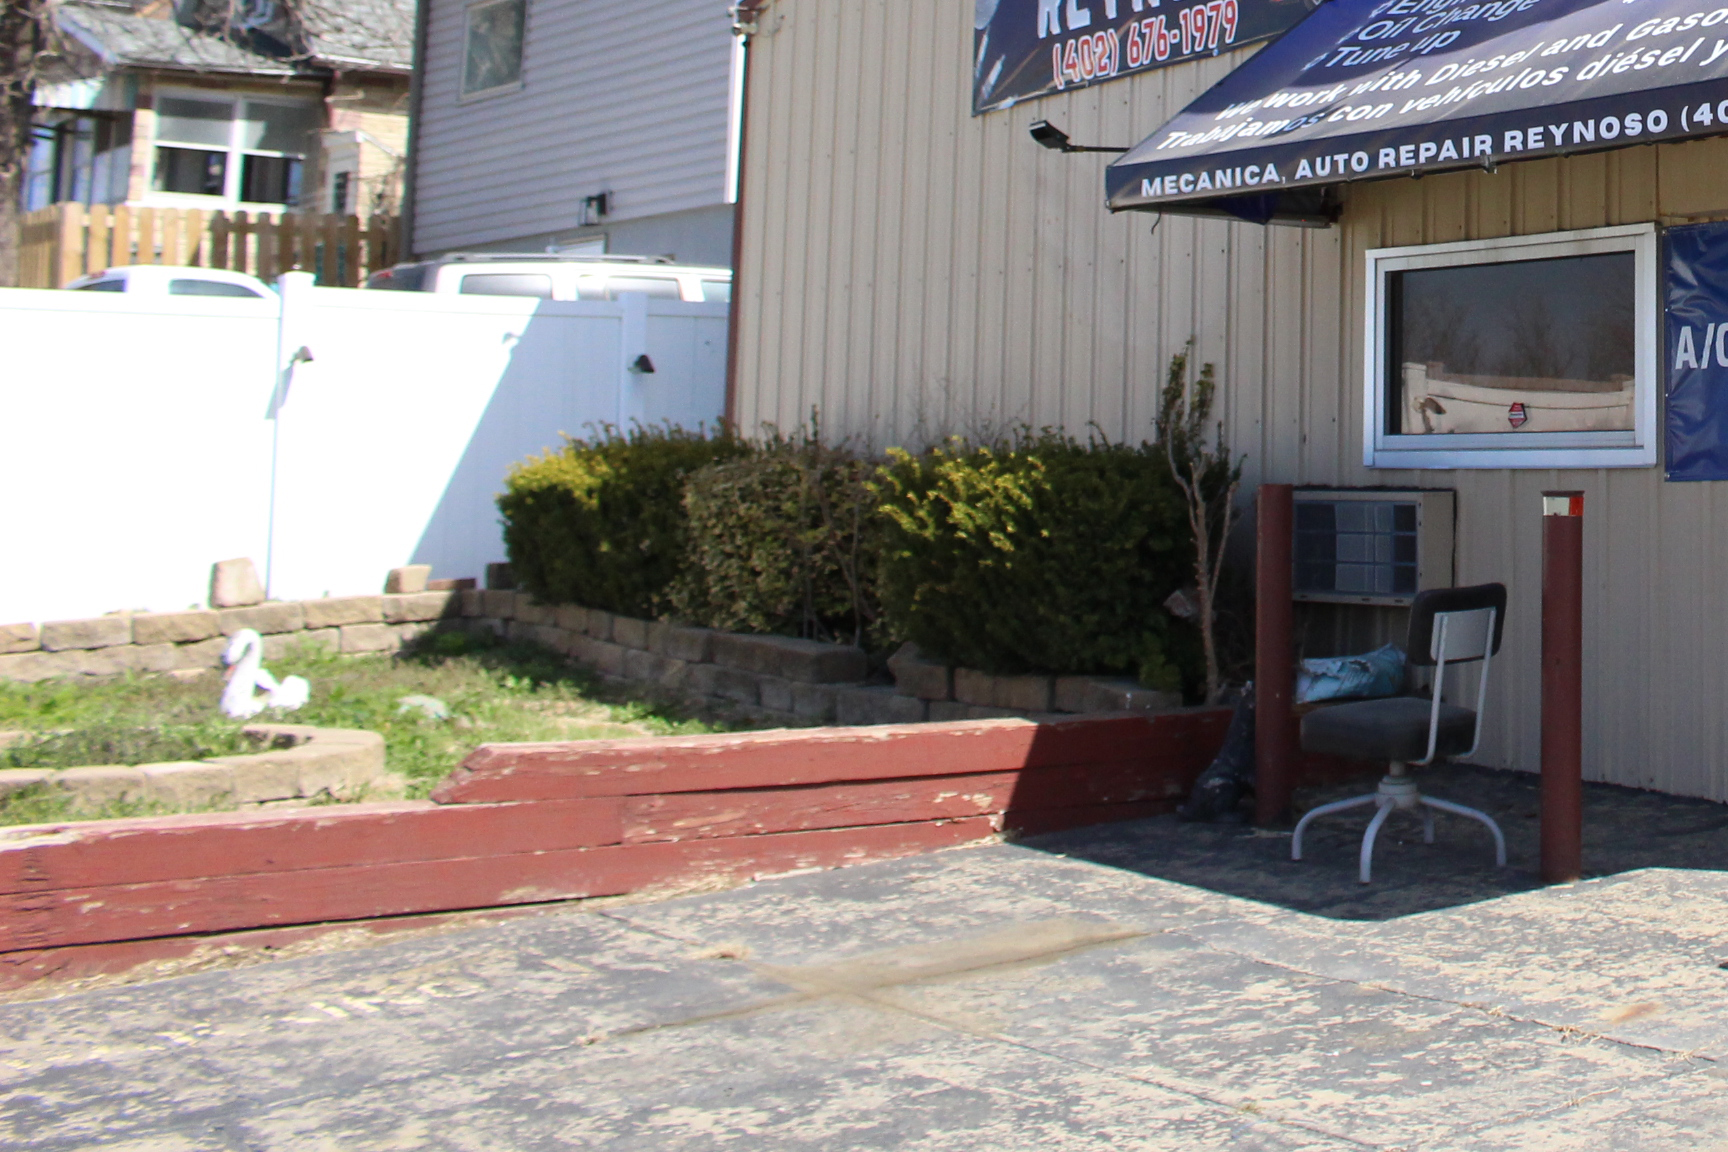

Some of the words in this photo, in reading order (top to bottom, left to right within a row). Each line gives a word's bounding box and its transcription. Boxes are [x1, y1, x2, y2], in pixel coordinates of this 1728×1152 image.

[1052, 29, 1119, 90] (402)
[1325, 40, 1412, 69] Tune
[1411, 30, 1462, 55] up
[1357, 15, 1409, 42] Oil
[1157, 114, 1325, 150] Trabajamos
[1328, 102, 1394, 123] con
[1398, 65, 1569, 115] vehículos
[1576, 37, 1698, 81] diésel
[1215, 98, 1262, 120] We
[1262, 84, 1350, 109] work
[1348, 65, 1422, 96] with
[1424, 41, 1545, 87] Diesel
[1540, 23, 1624, 57] and
[1141, 162, 1287, 198] MECANICA,
[1294, 151, 1370, 181] AUTO
[1378, 134, 1493, 170] REPAIR
[1504, 109, 1669, 153] REYNOSO
